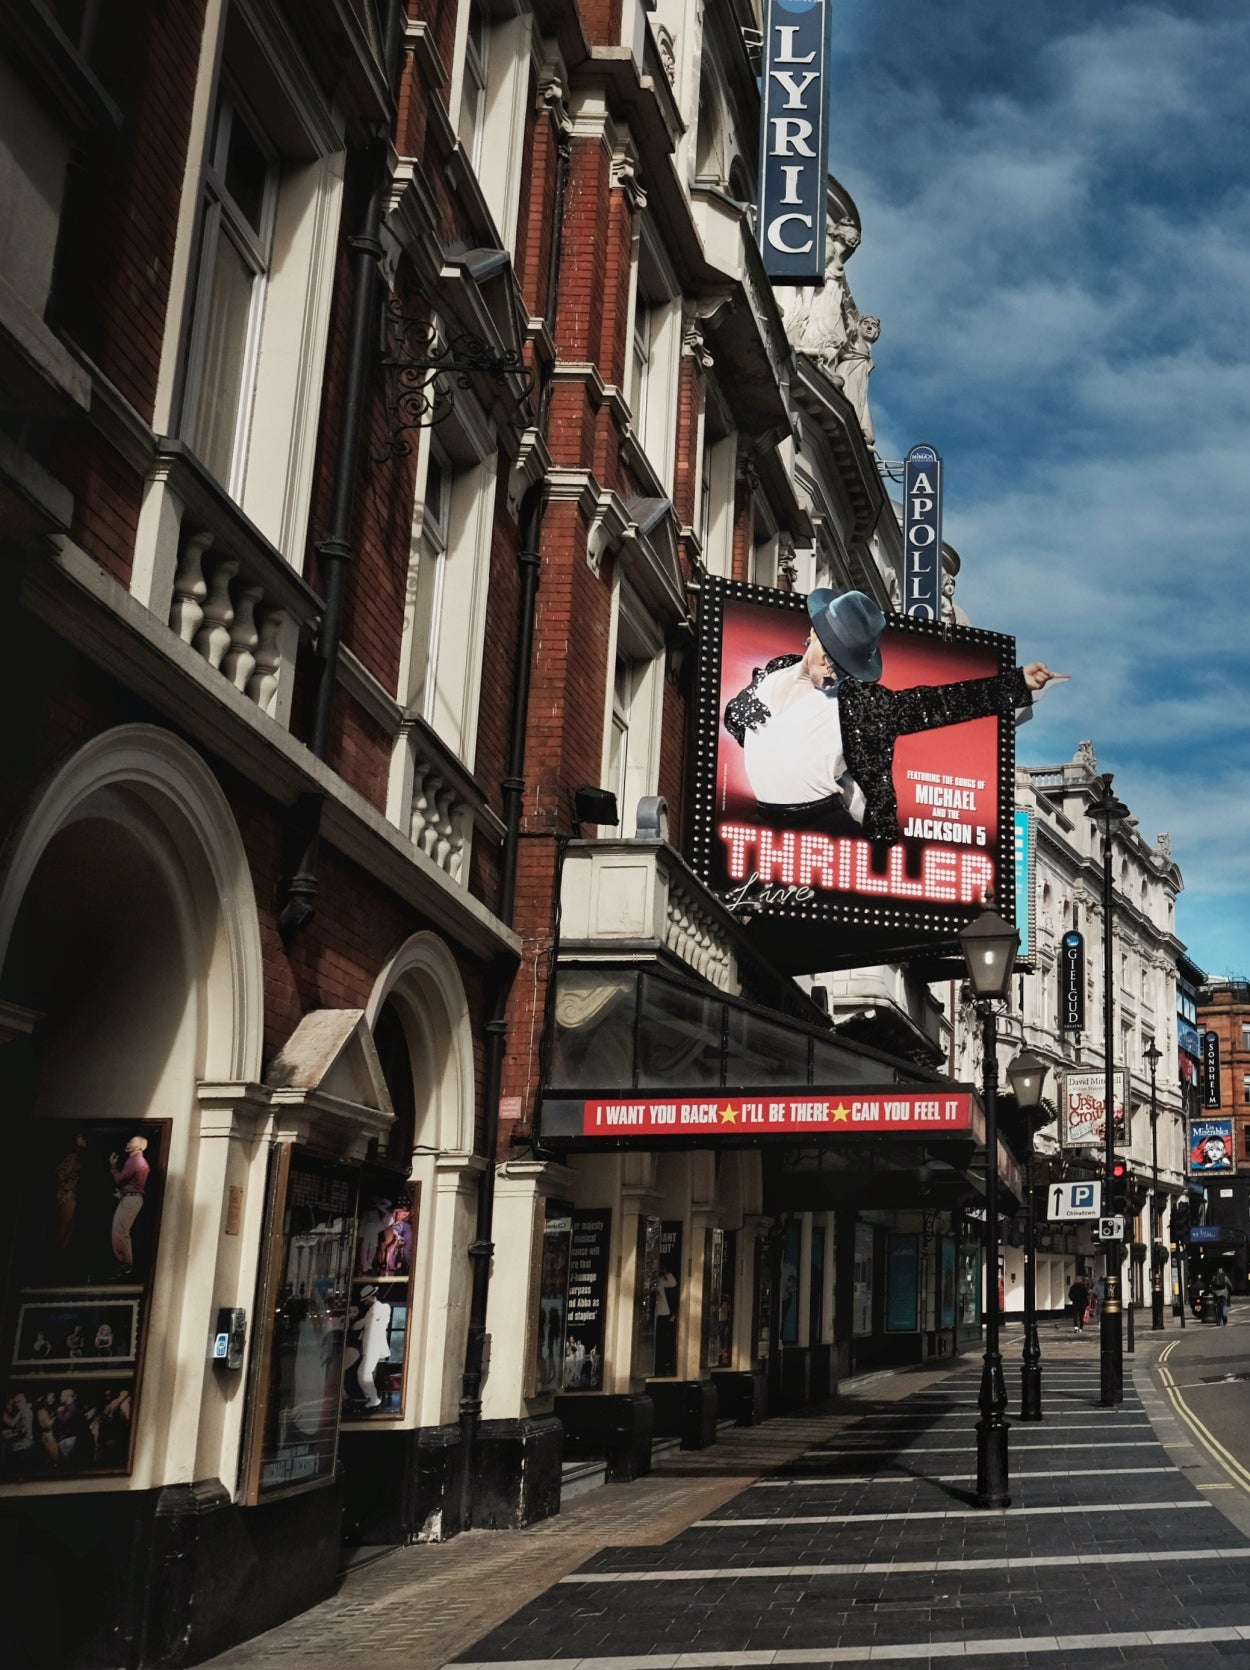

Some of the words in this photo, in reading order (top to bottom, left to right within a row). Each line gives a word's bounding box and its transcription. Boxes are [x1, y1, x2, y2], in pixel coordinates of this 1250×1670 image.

[768, 25, 820, 254] LYRIC
[907, 770, 941, 783] FEATURING
[942, 775, 954, 785] THE
[955, 777, 976, 788] SONGS
[977, 780, 986, 790] OF
[915, 784, 976, 811] MICHAEL
[932, 807, 946, 818] AND
[947, 809, 960, 820] THE
[903, 817, 972, 844] JACKSON
[976, 826, 986, 846] 5
[720, 824, 992, 904] THRILLER
[725, 871, 815, 911] Live
[1067, 948, 1079, 1023] GIELGUD
[1069, 1077, 1089, 1086] David
[1208, 1043, 1216, 1103] SONDHEIM
[596, 1106, 602, 1125] I
[606, 1106, 645, 1125] WANT
[650, 1105, 676, 1124] YOU
[680, 1104, 718, 1124] BACK
[741, 1103, 764, 1123] I'LL
[769, 1103, 785, 1122] BE
[790, 1102, 829, 1122] THERE
[852, 1102, 879, 1121] CAN
[884, 1101, 910, 1120] YOU
[914, 1101, 941, 1120] FEEL
[945, 1101, 958, 1120] IT
[1069, 1110, 1104, 1128] Crow
[1075, 1187, 1090, 1206] P
[579, 1259, 592, 1269] that
[577, 1298, 591, 1308] Abba
[592, 1299, 600, 1308] as
